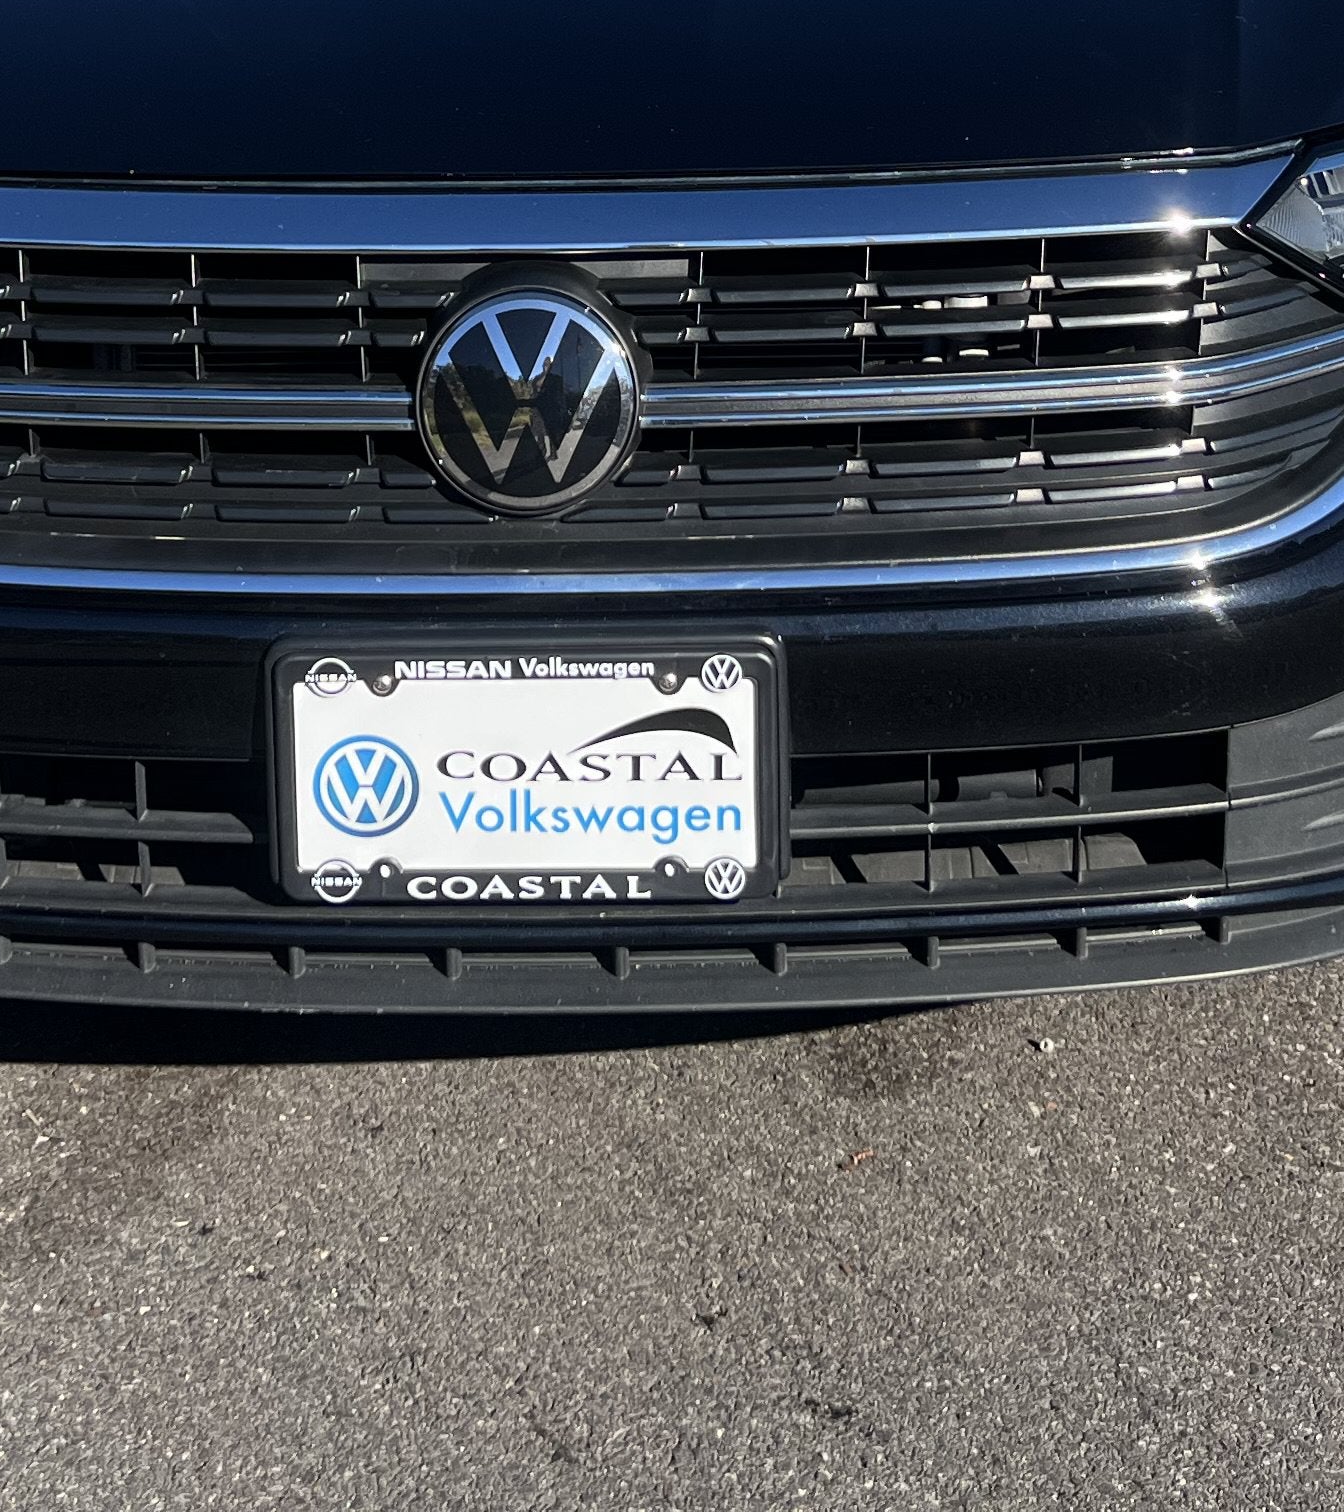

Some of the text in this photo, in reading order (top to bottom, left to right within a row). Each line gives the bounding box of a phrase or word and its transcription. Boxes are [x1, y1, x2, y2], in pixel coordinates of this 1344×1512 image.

[395, 657, 655, 679] NISSAN Volkswagen
[436, 751, 743, 782] COASTAL
[439, 789, 742, 845] Volkswagen
[406, 874, 652, 900] COASTAL
